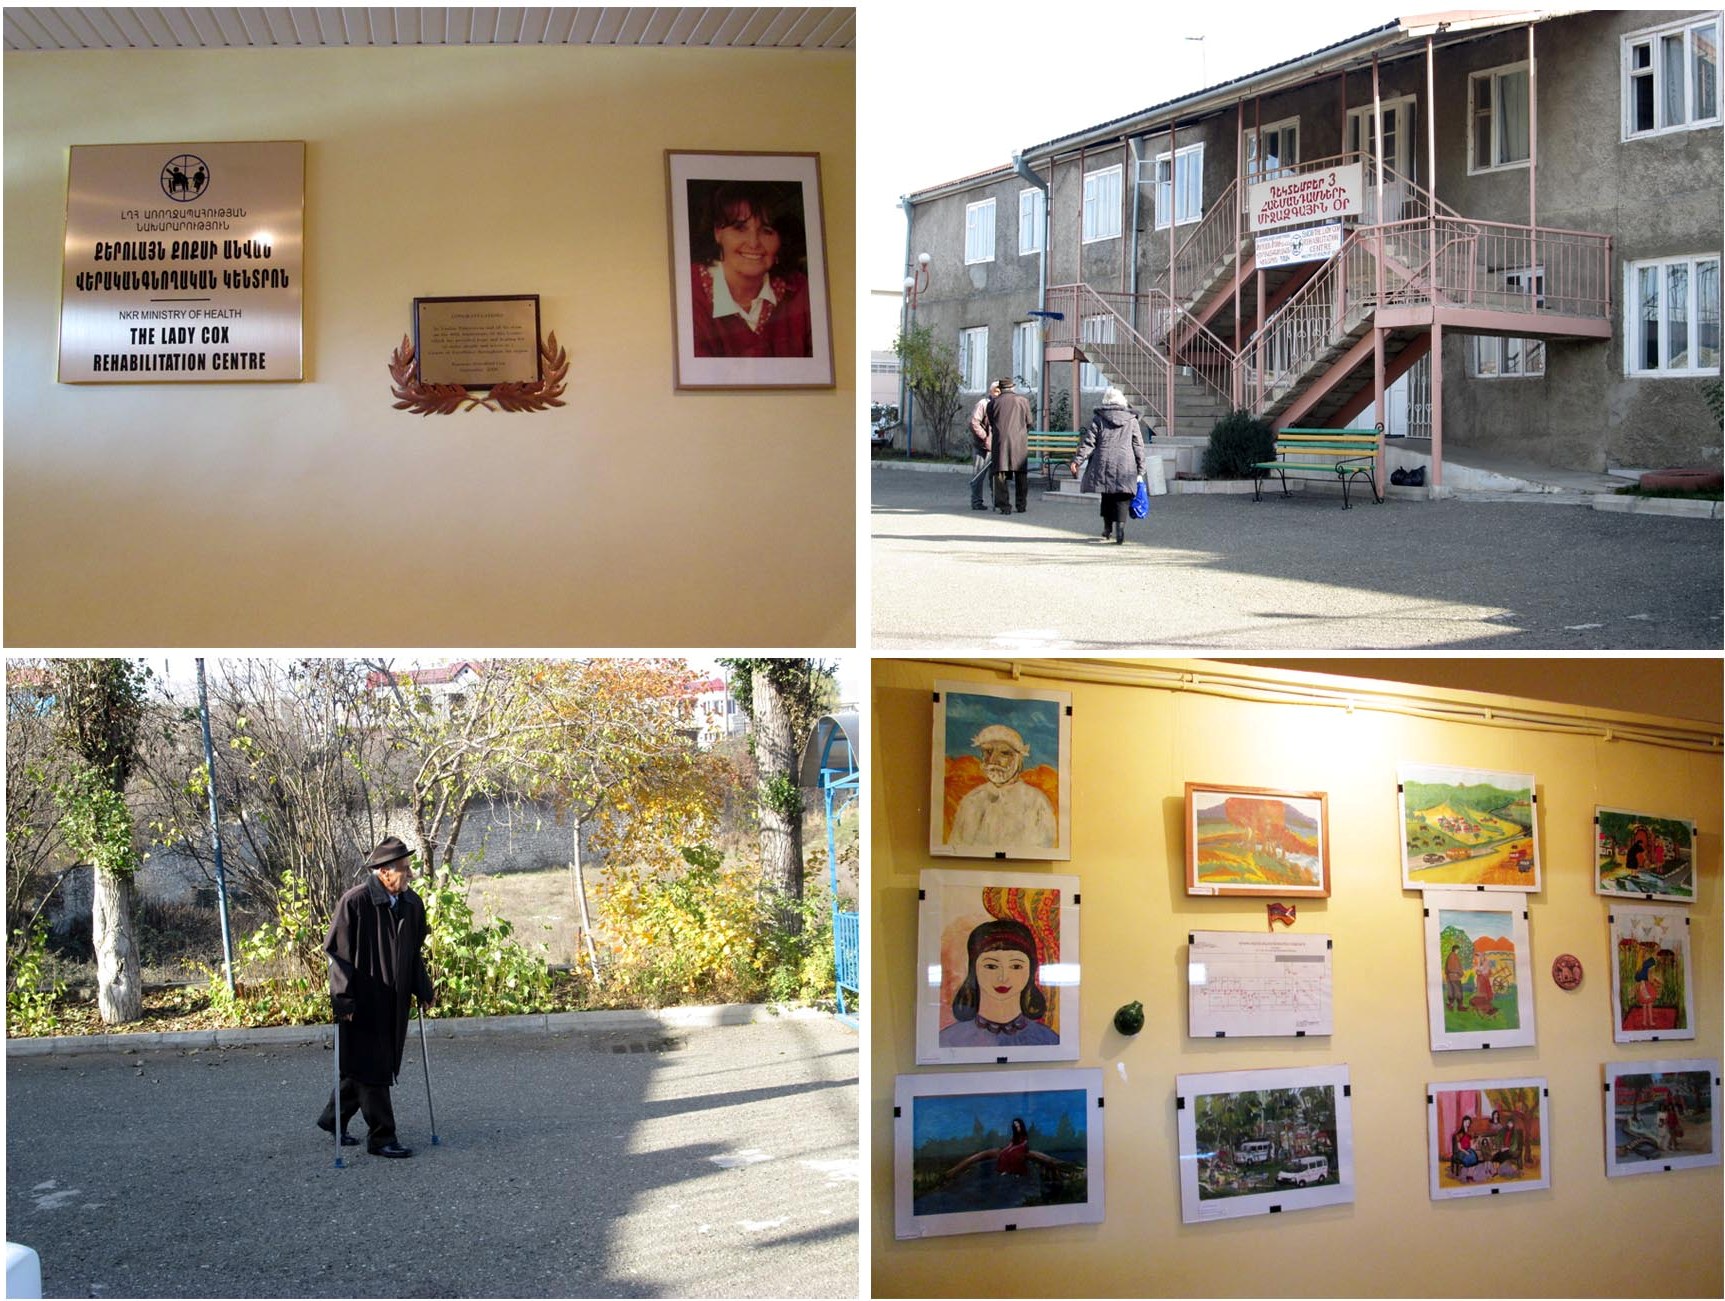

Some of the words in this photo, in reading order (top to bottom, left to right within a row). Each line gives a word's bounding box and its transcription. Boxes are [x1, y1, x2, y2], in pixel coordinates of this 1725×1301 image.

[121, 210, 139, 220] ԼՂՀ
[94, 240, 166, 262] ՔԵՐՈԼԱՅՆ
[171, 240, 217, 260] ՔՈՔՍԻ
[76, 269, 217, 291] ՎԵՐԱԿԱՆԳՆՈՂԱԿԱՆ
[223, 268, 289, 289] ԿԵՆՏՐՈՆ
[119, 310, 139, 320] NKR
[141, 310, 187, 320] MINISTRY
[189, 309, 202, 319] OF
[203, 309, 242, 319] HEALTH
[130, 327, 155, 345] THE
[161, 327, 195, 345] LADY
[201, 326, 229, 344] COX
[93, 353, 206, 372] REHABILITATION
[212, 352, 266, 371] CENTRE
